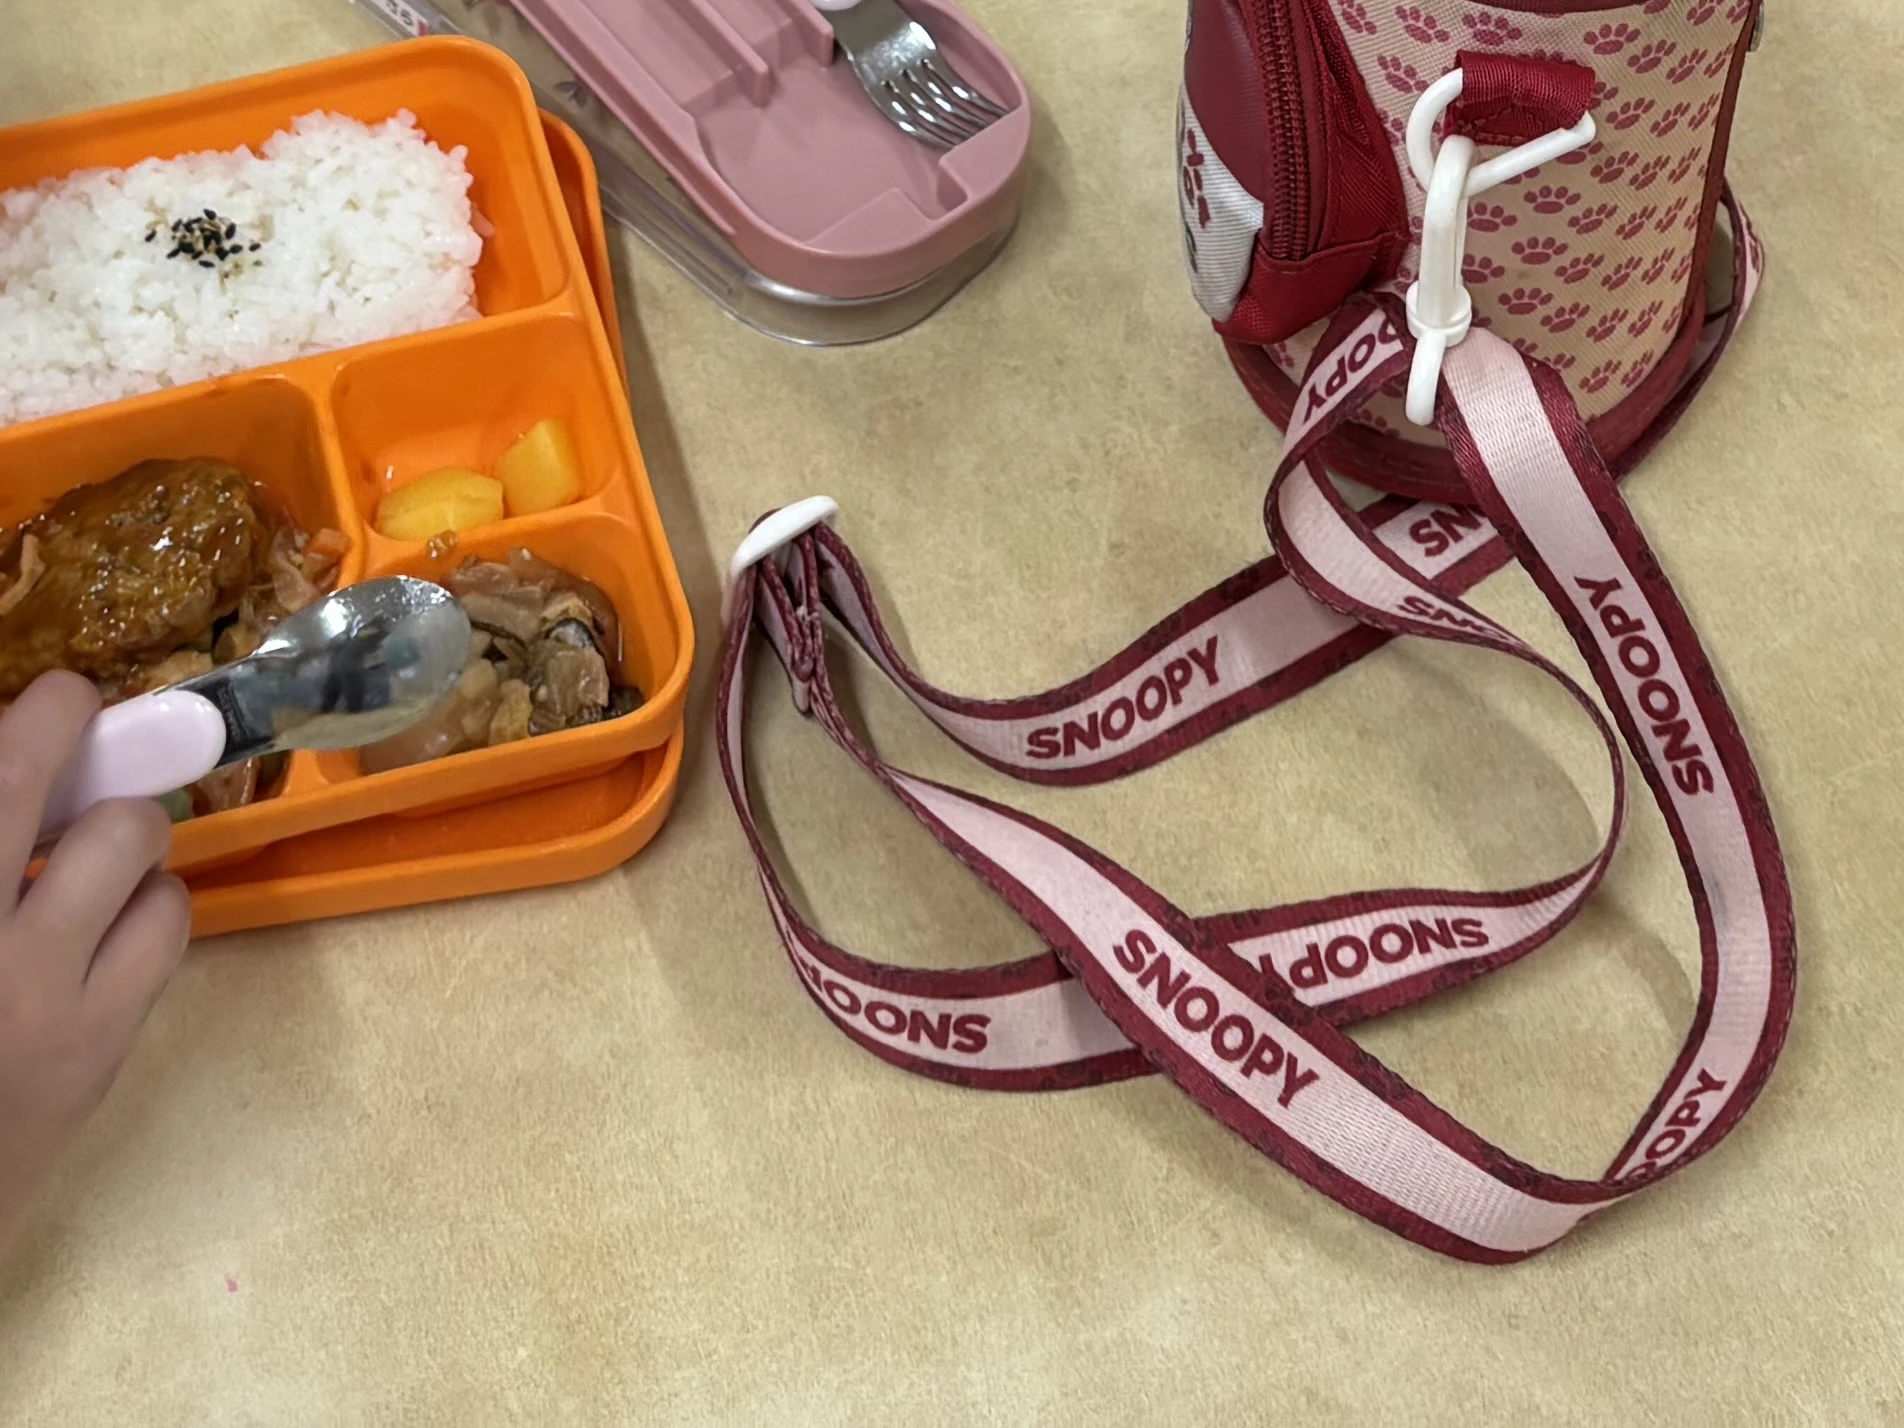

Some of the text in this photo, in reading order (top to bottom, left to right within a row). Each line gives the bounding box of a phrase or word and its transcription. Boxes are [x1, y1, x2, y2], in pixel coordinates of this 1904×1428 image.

[1025, 633, 1222, 762] SNOOPY
[1575, 574, 1714, 800] SNOOPY
[1113, 927, 1319, 1111] SNOOPY
